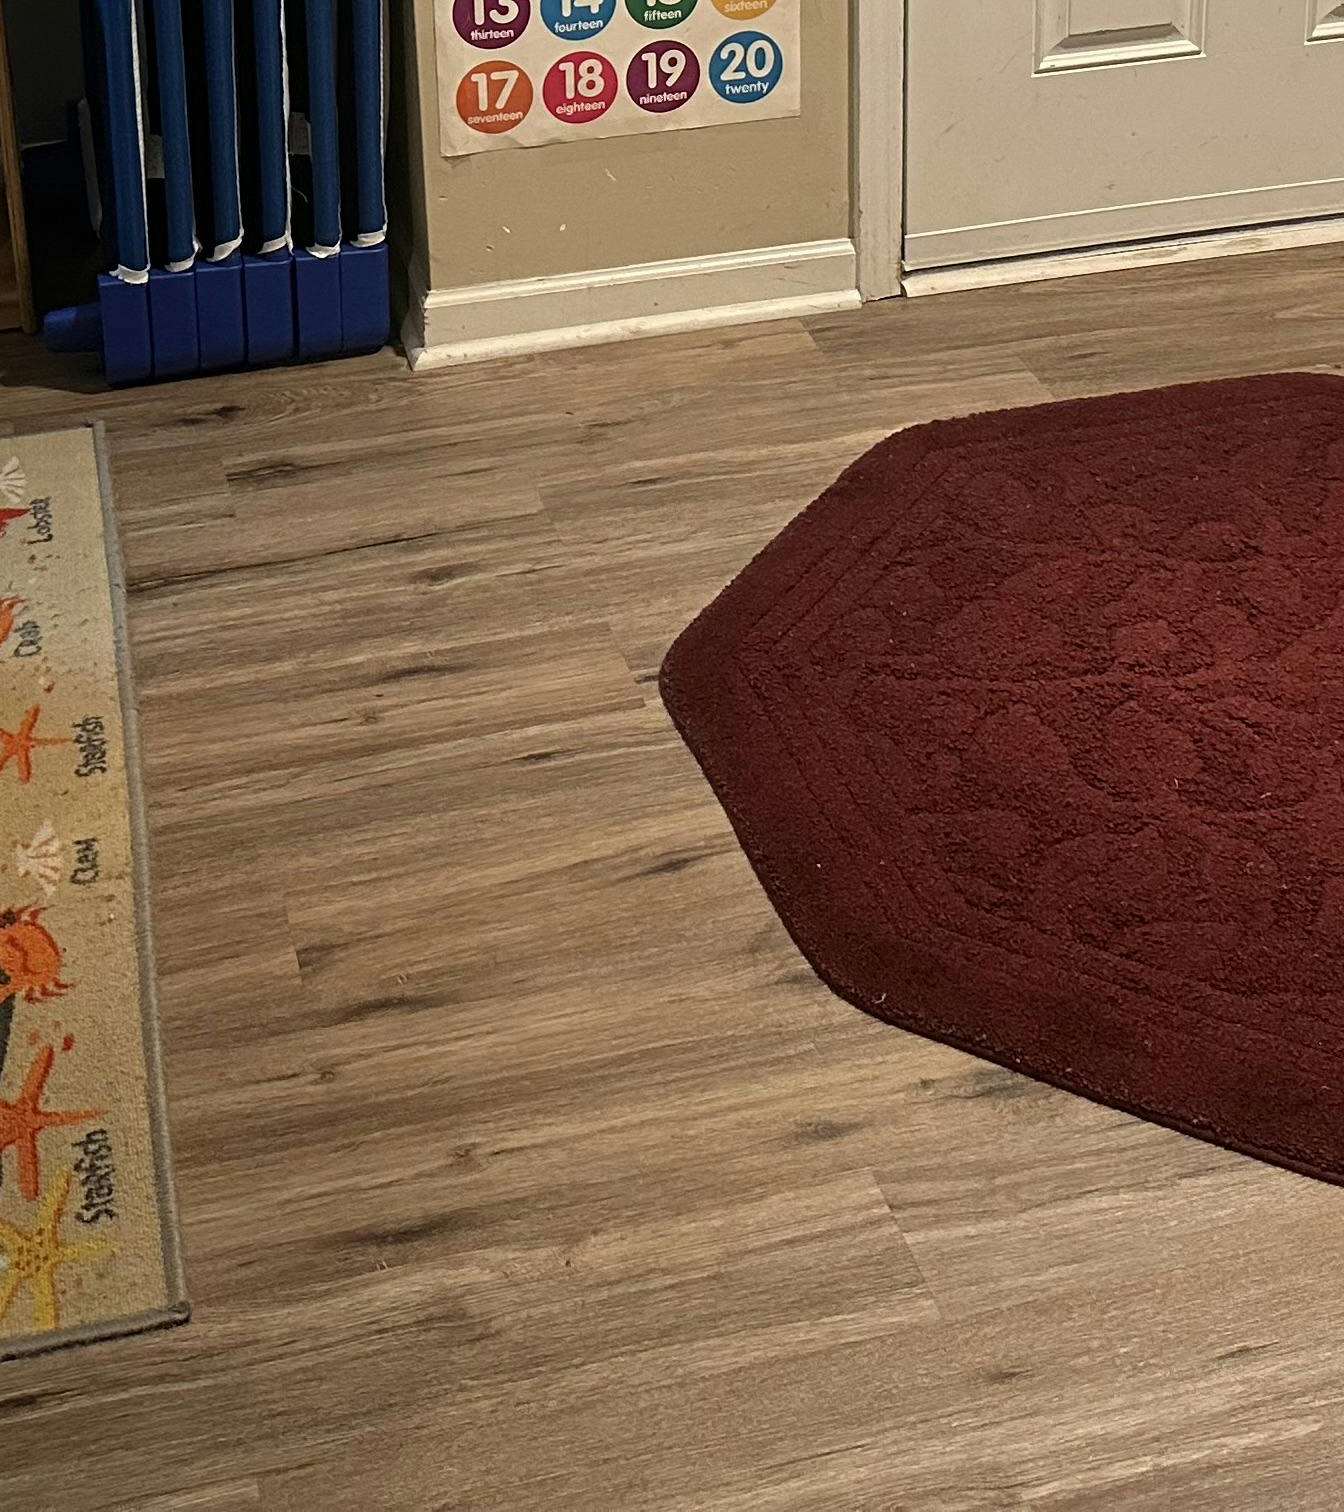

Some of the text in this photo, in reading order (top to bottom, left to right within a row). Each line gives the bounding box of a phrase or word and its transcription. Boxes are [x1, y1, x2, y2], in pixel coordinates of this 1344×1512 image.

[644, 8, 682, 22] fifteen
[470, 27, 514, 41] thirteen
[555, 19, 603, 34] fourteen
[720, 41, 775, 81] 20
[640, 50, 687, 89] 19
[558, 59, 605, 100] 18
[470, 70, 519, 112] 17
[725, 81, 769, 95] twenty
[640, 90, 687, 105] nineteen
[556, 99, 606, 114] eighteen
[467, 110, 524, 124] seventeen
[27, 496, 53, 545] Lobster
[71, 1128, 119, 1224] Starfish
